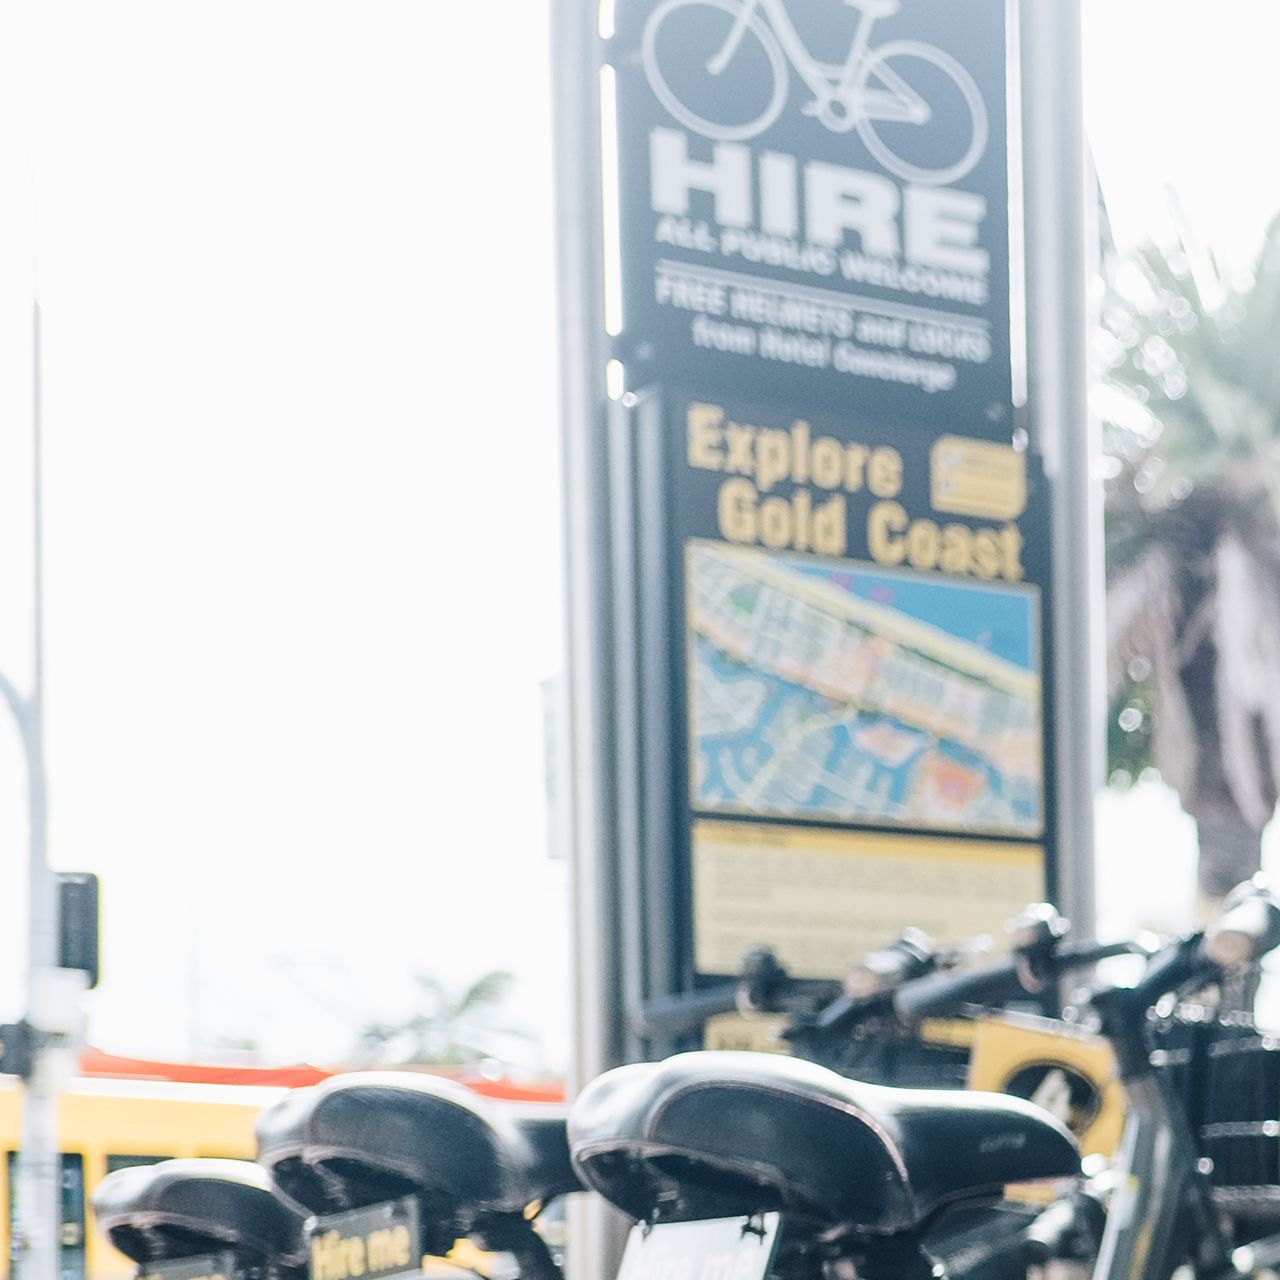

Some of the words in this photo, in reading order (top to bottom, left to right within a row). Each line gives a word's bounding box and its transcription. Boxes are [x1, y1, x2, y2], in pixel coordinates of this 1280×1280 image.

[649, 126, 991, 277] HIRE
[654, 276, 728, 317] FREE
[655, 217, 718, 254] ALL
[720, 227, 836, 277] PUBLIC
[838, 252, 990, 306] WELCOME
[686, 401, 903, 499] Explore
[717, 475, 847, 556] Gold
[866, 501, 1025, 581] Coast
[366, 1225, 412, 1272] me
